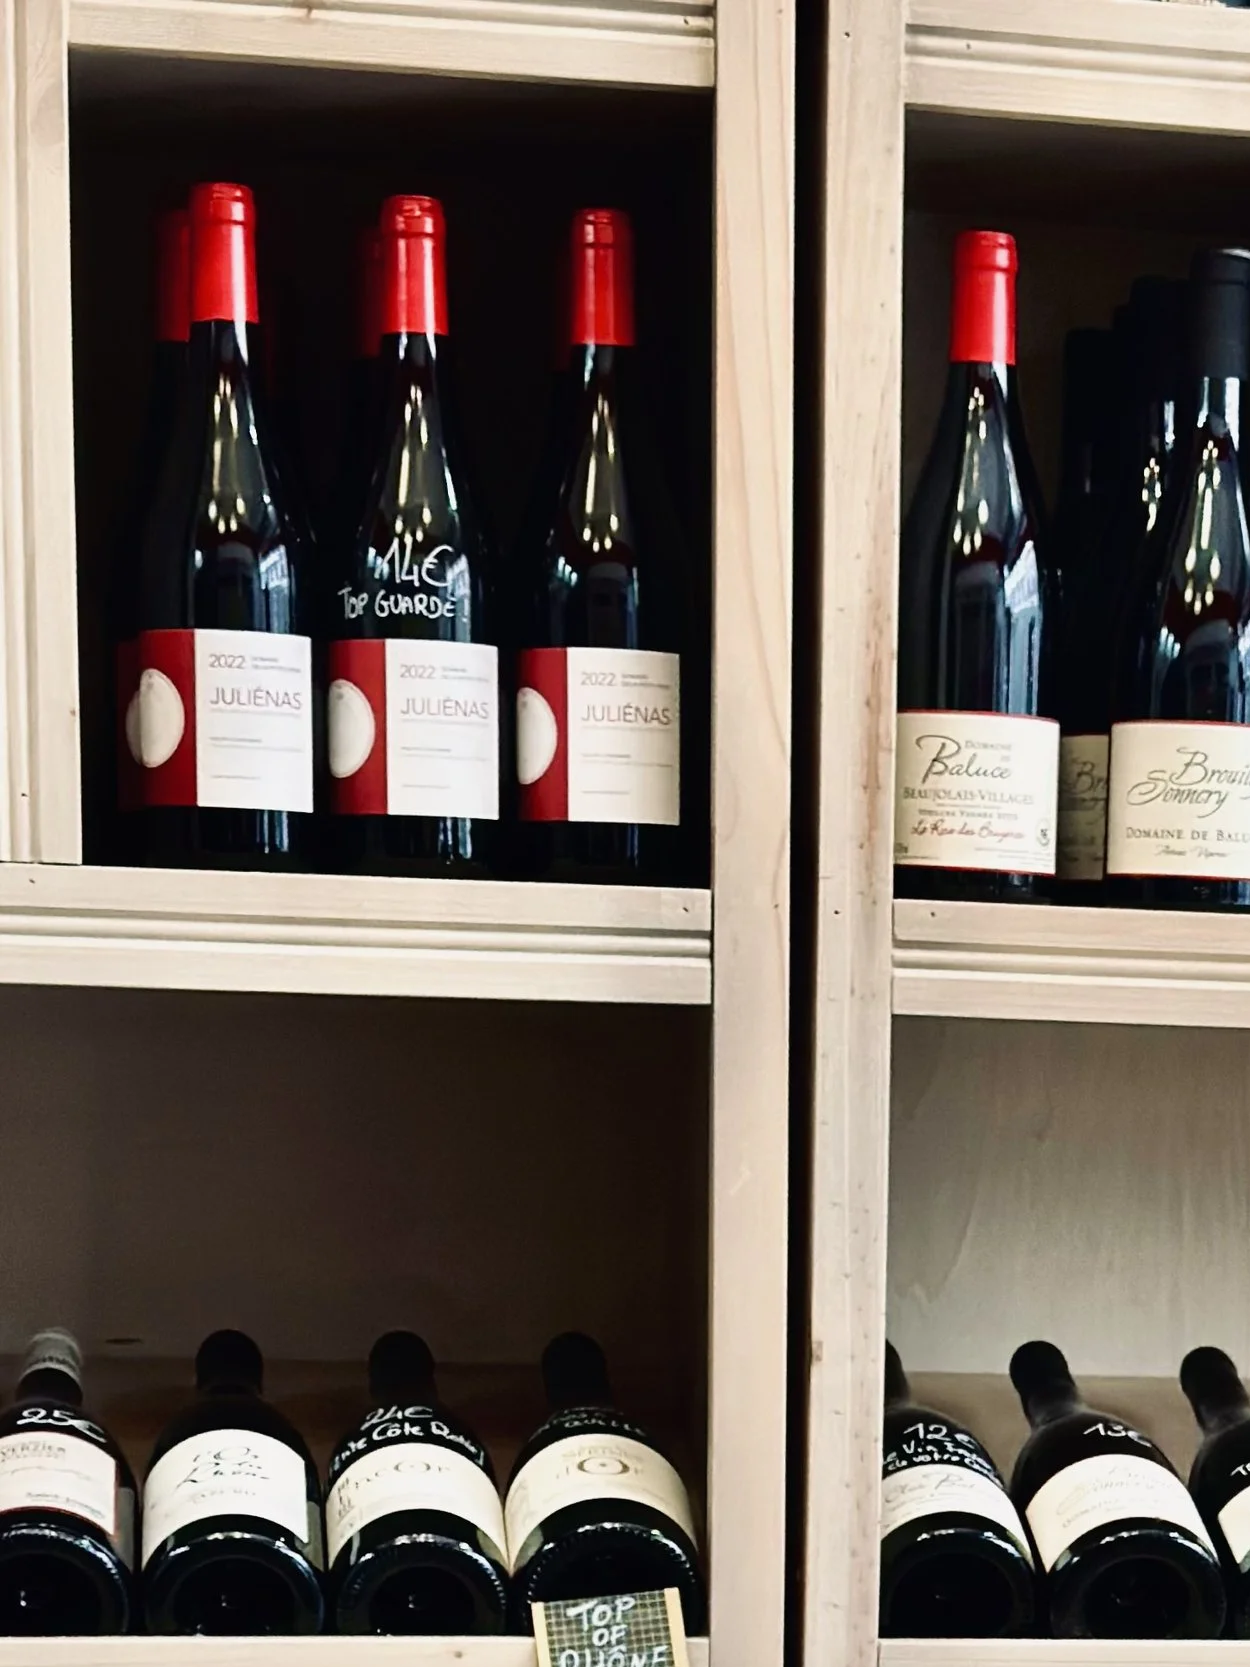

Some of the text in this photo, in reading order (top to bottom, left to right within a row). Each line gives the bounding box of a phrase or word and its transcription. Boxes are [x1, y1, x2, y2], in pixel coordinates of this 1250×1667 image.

[208, 654, 246, 670] 2022
[400, 664, 437, 680] 2022
[580, 671, 617, 687] 2022
[209, 685, 304, 711] JULIÉNAS
[400, 696, 490, 720] JULIÉNAS
[580, 702, 672, 726] JULIÉNAS
[915, 734, 1013, 784] Baluce
[1126, 826, 1184, 841] DOMAINE
[1190, 828, 1209, 841] DE
[566, 1596, 636, 1632] TOP
[592, 1624, 628, 1647] OF
